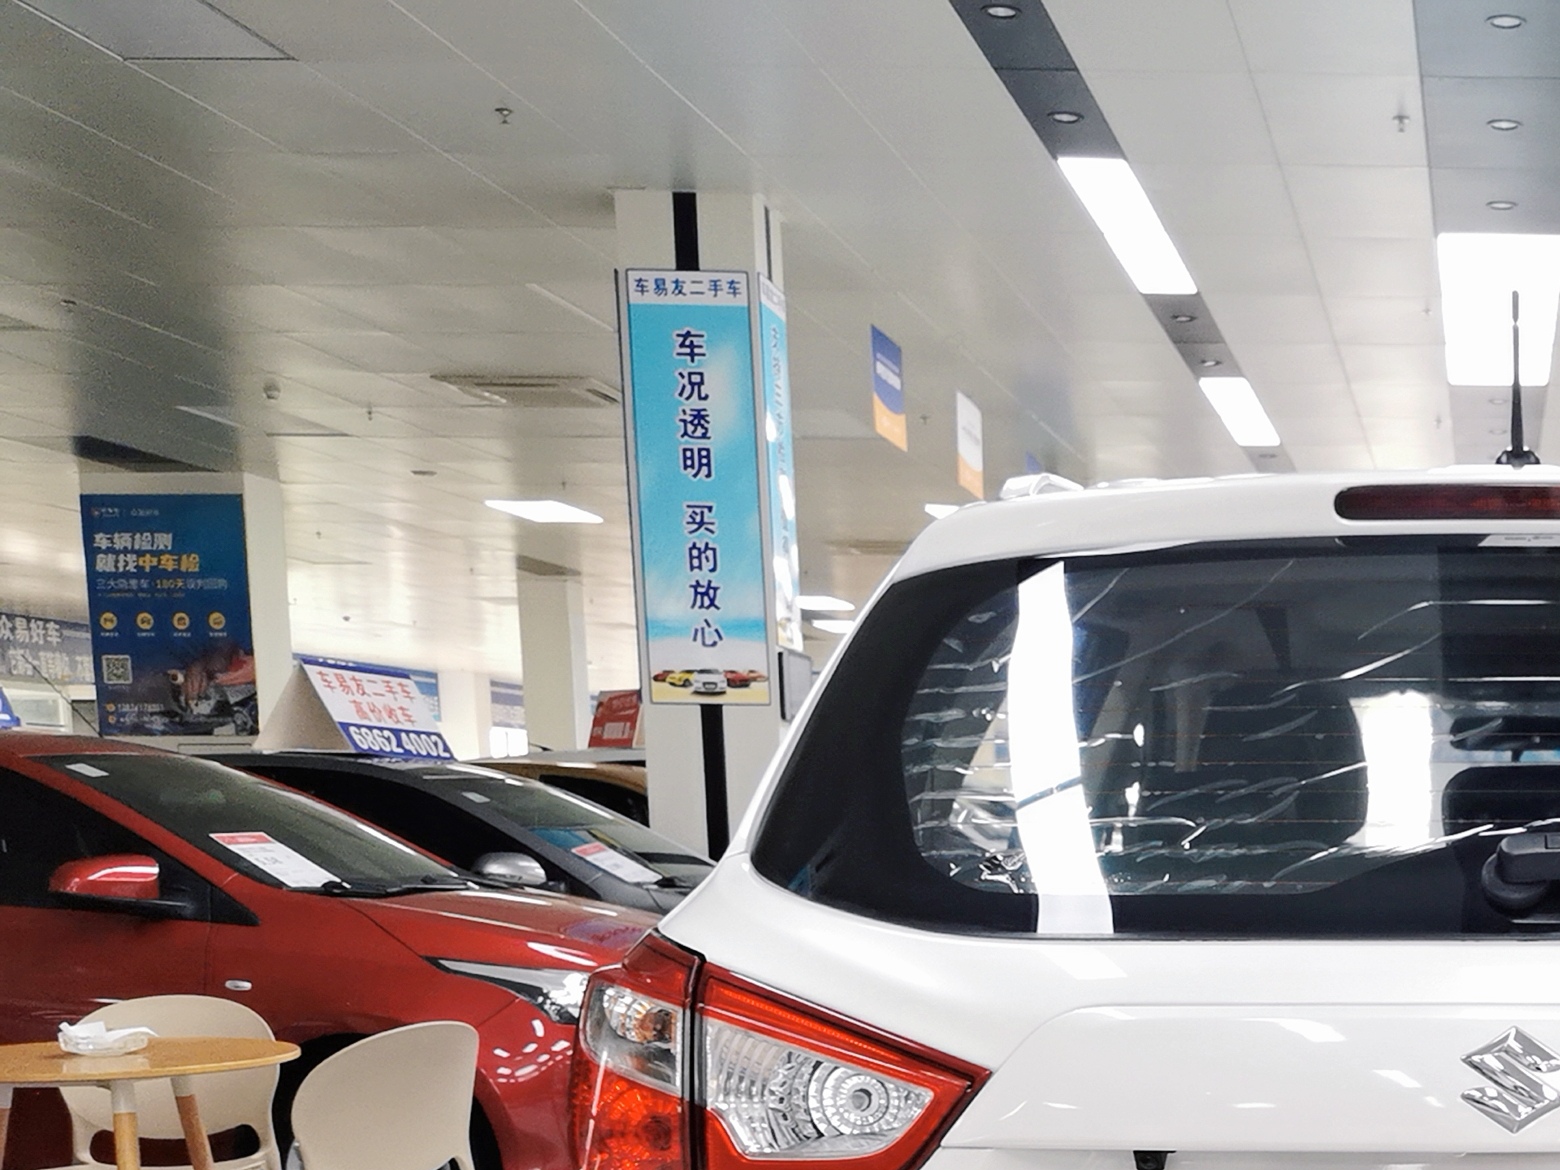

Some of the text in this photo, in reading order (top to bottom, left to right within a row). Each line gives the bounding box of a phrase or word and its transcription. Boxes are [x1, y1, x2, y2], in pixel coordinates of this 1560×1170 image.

[634, 277, 742, 298] 车易友二手车
[674, 329, 723, 648] 车况透明 买的放心
[93, 532, 173, 550] 车辆检测
[316, 670, 416, 702] 车易友二手车
[349, 699, 417, 726] 高价收车
[349, 726, 451, 758] 6862 4002
